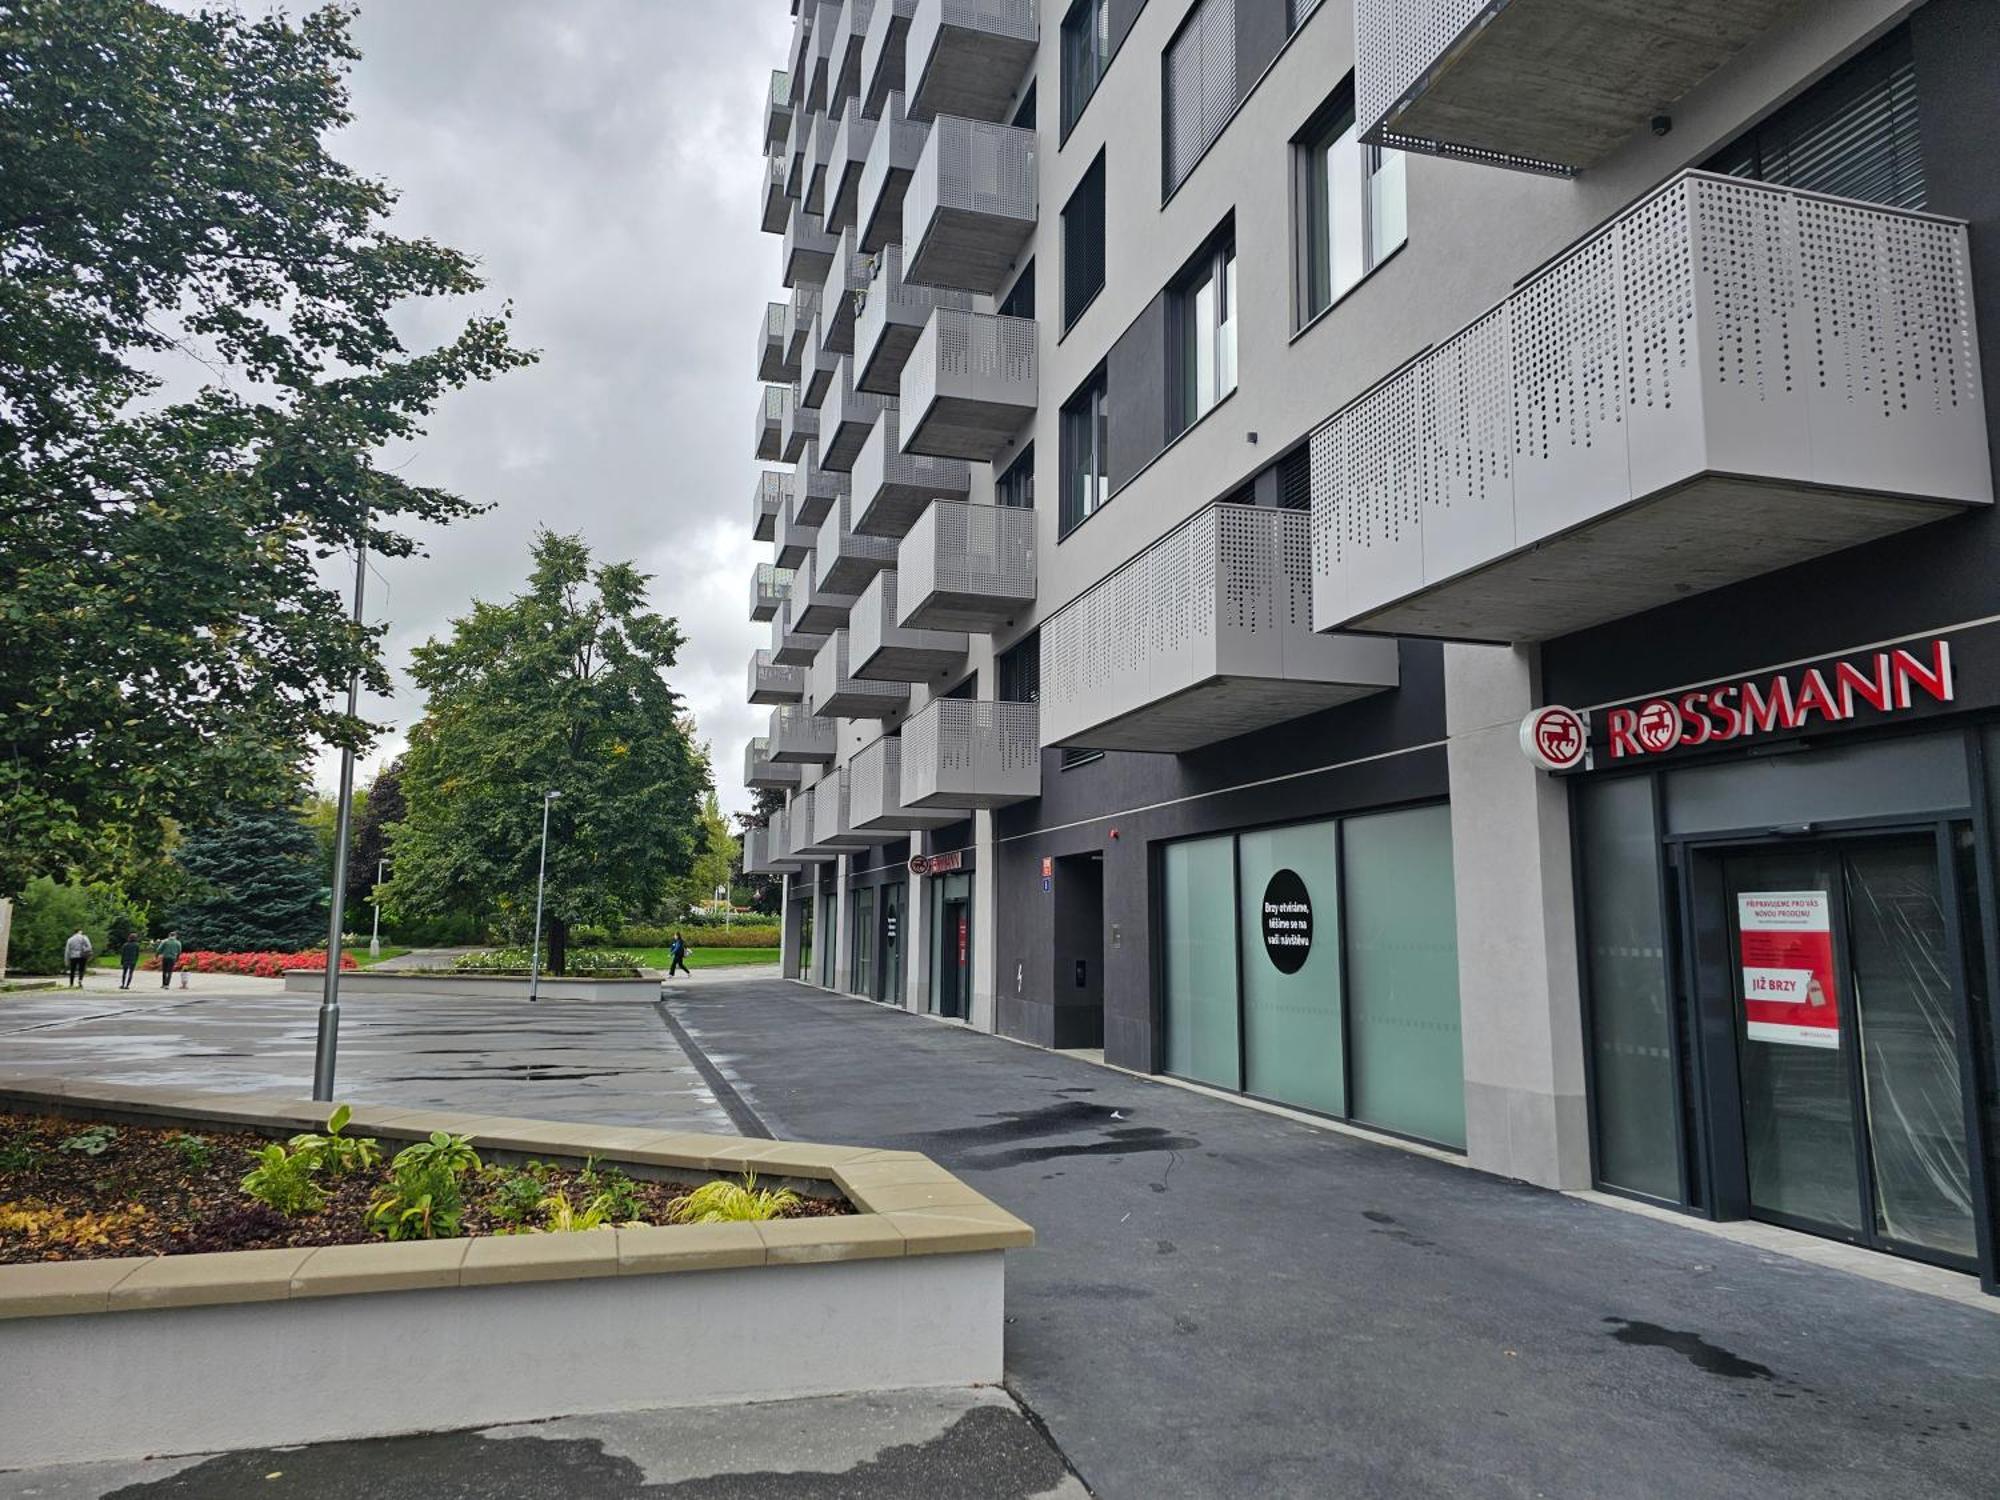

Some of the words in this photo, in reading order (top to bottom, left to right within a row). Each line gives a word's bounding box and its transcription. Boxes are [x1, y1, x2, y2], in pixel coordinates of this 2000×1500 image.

[1608, 640, 1954, 759] ROSSMANN
[1265, 902, 1278, 915] Brzy
[1791, 899, 1805, 907] PRO
[1754, 910, 1776, 918] NOVOU
[1290, 920, 1298, 929] se
[1299, 920, 1307, 929] na
[1752, 976, 1766, 991] JIŽ
[1768, 979, 1797, 992] BRZY
